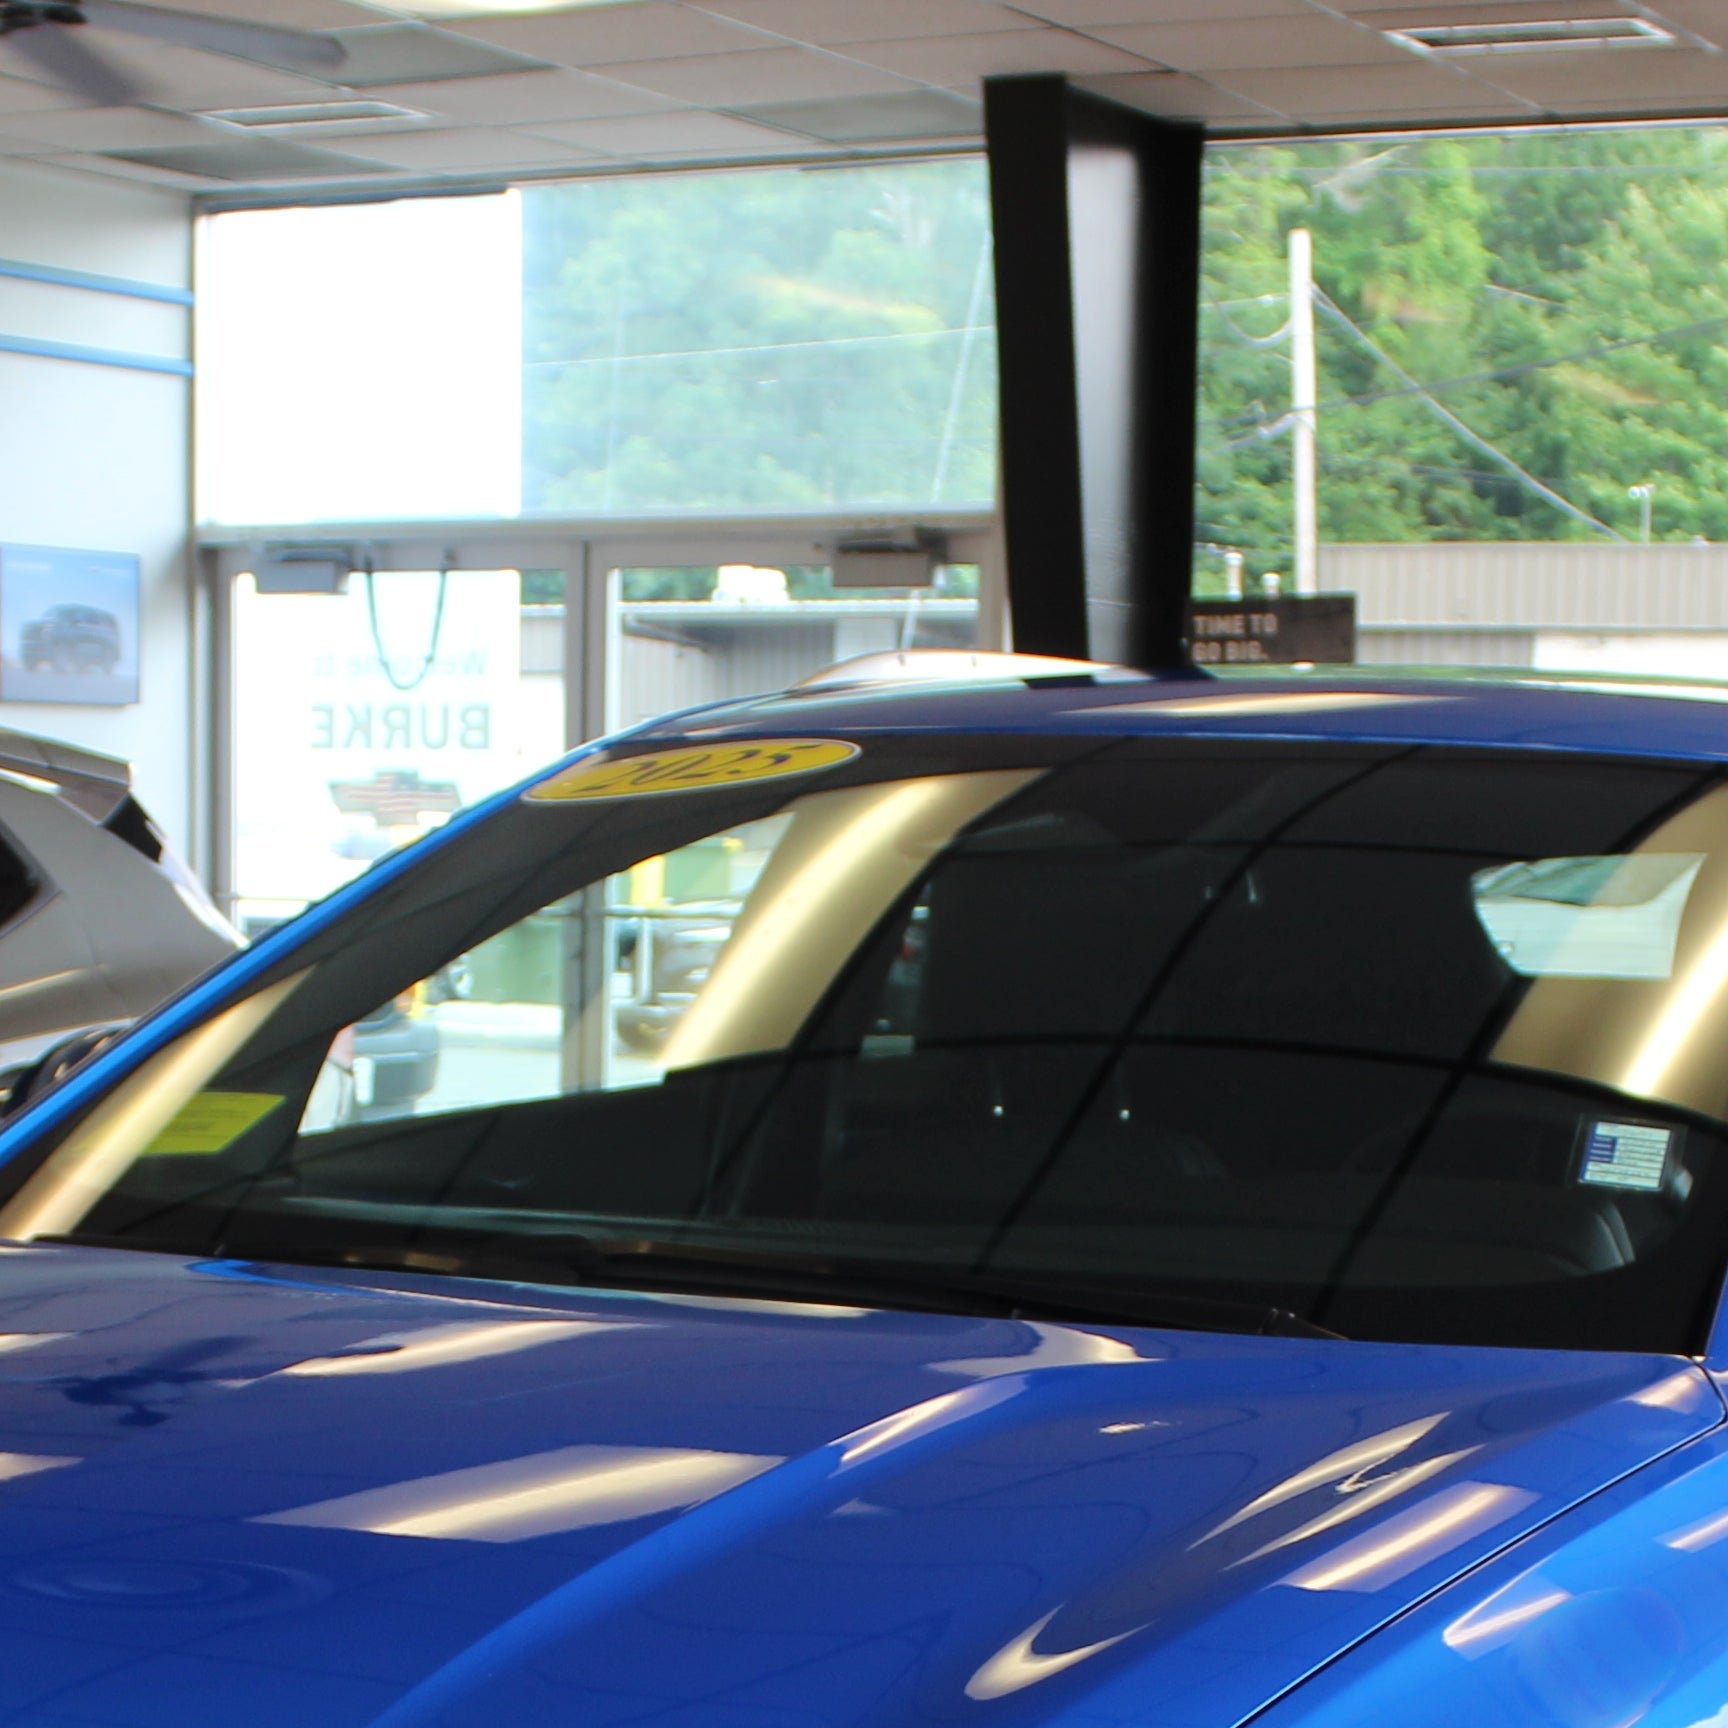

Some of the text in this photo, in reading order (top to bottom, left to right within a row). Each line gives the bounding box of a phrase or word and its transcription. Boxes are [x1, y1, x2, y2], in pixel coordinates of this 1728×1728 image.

[1193, 612, 1279, 636] TIME TO
[1192, 640, 1221, 663] GO
[570, 743, 823, 793] 2025
